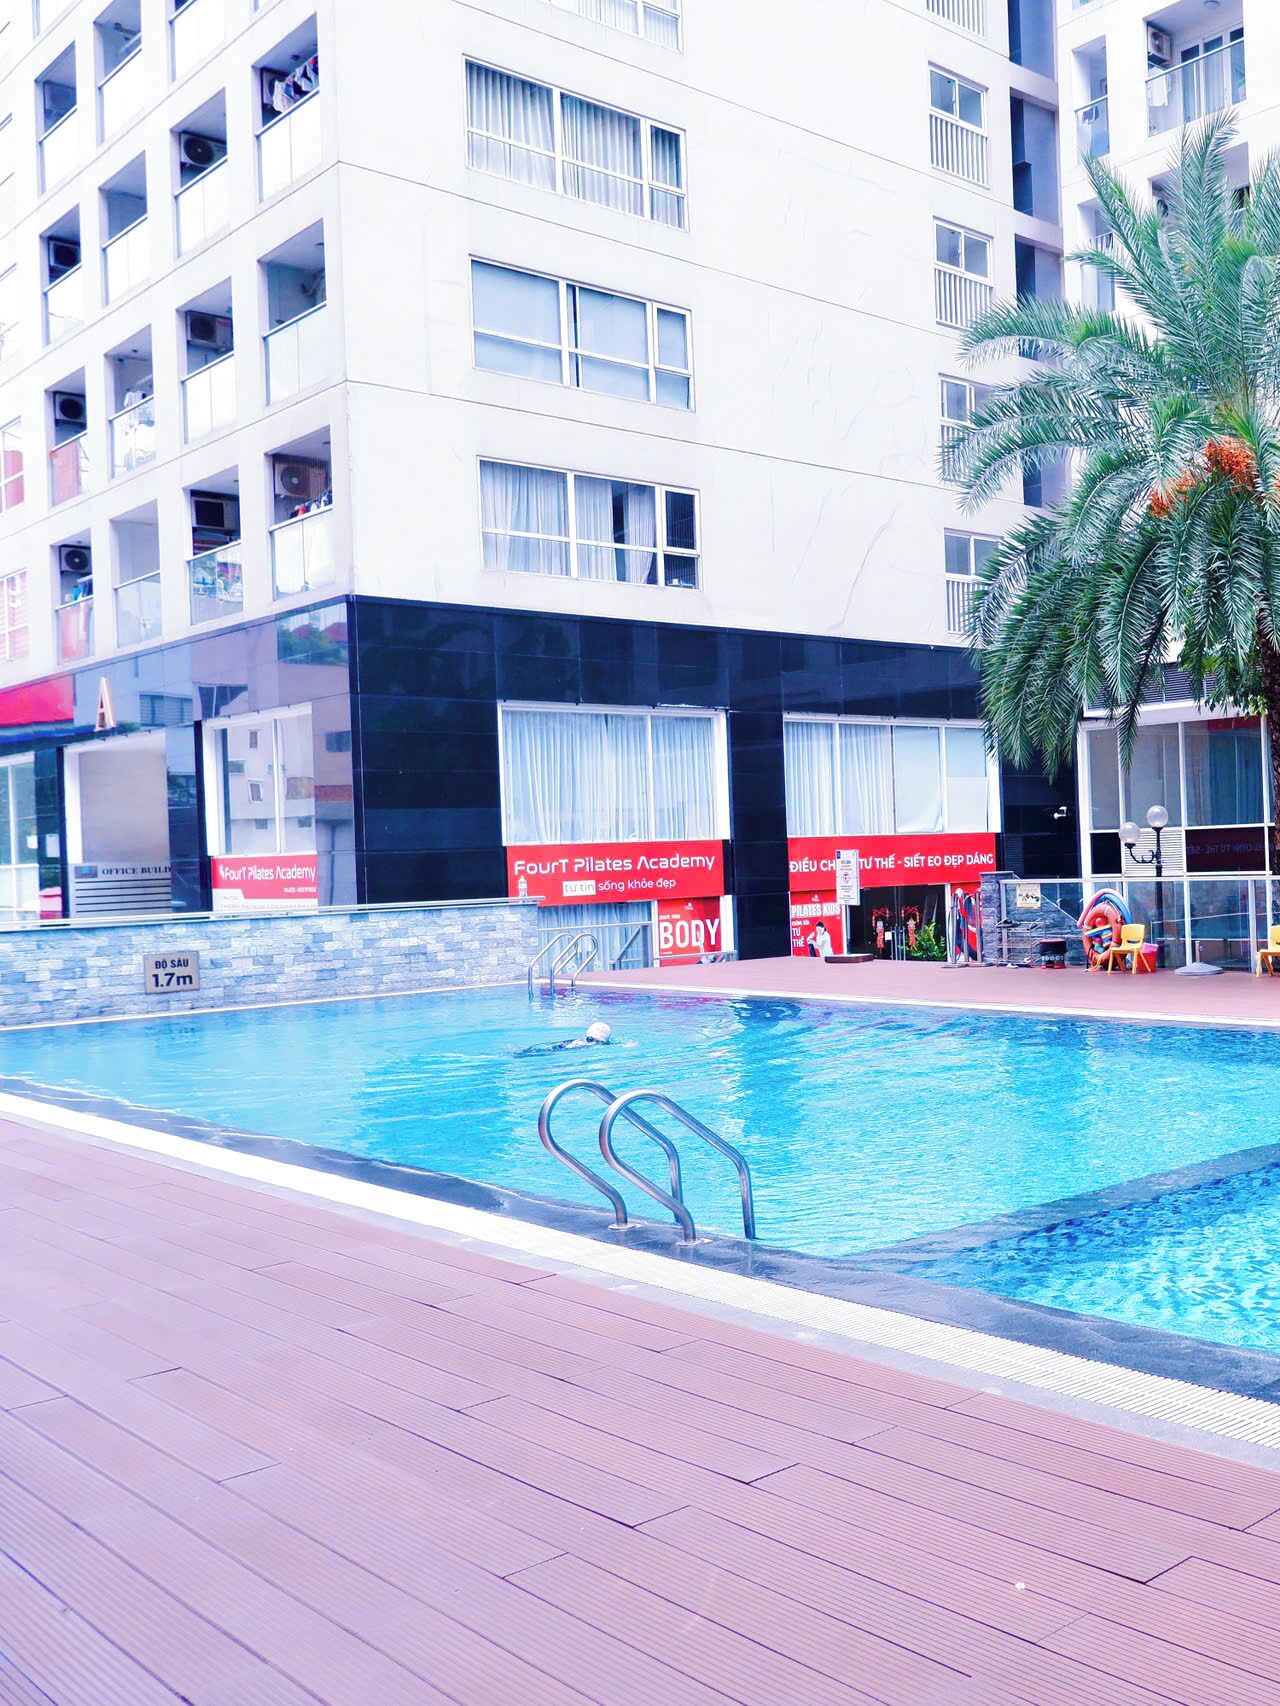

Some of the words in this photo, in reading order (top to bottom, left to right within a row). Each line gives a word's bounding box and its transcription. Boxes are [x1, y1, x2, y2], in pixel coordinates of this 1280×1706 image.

[514, 859, 569, 875] FourT
[574, 857, 633, 873] Pilates
[637, 853, 715, 871] Academy
[874, 854, 896, 869] THẾ
[903, 853, 926, 868] SIẾT
[927, 856, 942, 867] EO
[943, 855, 965, 868] ĐẸP
[966, 851, 994, 865] DÁNG
[102, 867, 138, 875] OFFICE
[224, 868, 247, 881] FourT
[247, 865, 275, 880] Pilates
[275, 864, 316, 883] Academy
[598, 880, 625, 892] sống
[627, 878, 654, 889] khỏe
[655, 877, 677, 889] đẹp
[791, 904, 822, 918] PILATES
[659, 918, 720, 949] BODY
[170, 957, 189, 968] SÂU
[152, 972, 193, 988] 1.7m
